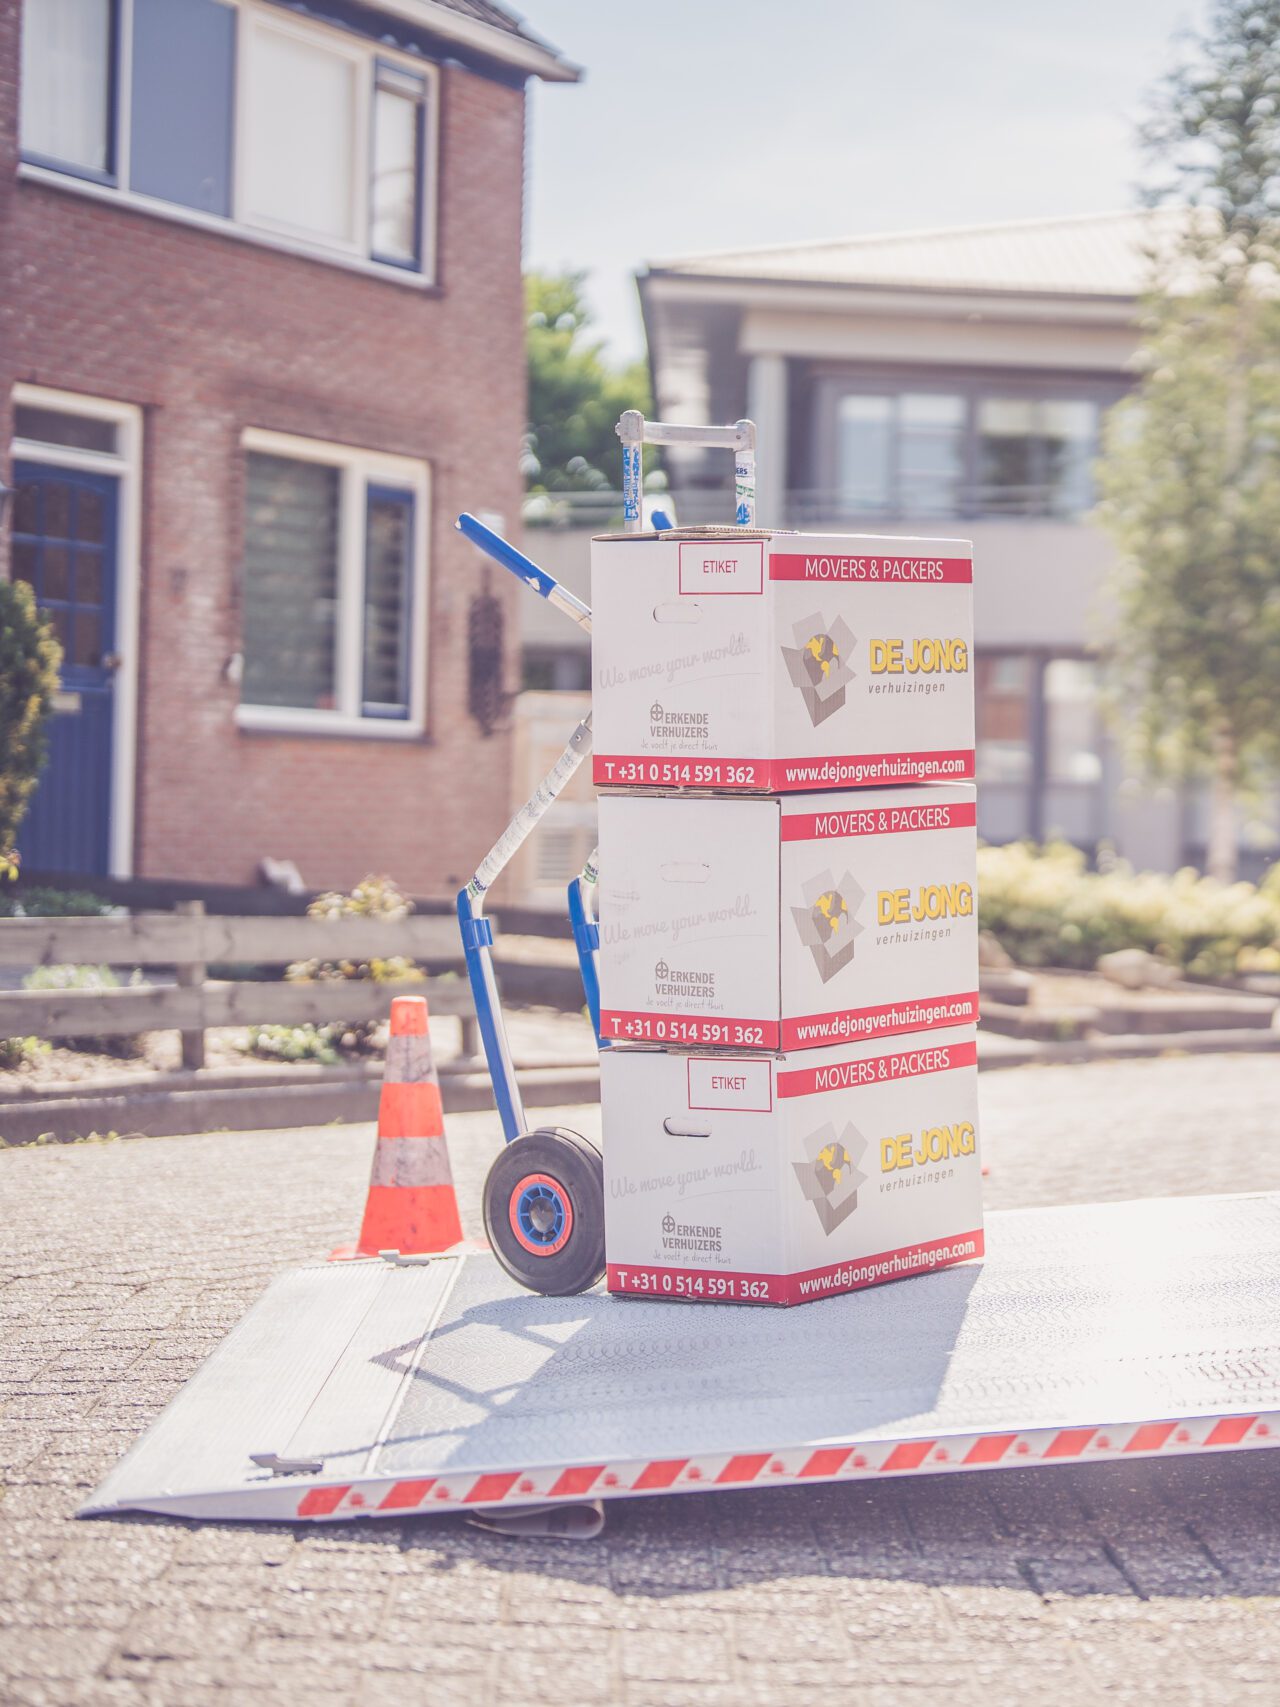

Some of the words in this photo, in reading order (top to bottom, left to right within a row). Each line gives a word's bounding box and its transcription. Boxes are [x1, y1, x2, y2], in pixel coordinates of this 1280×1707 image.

[703, 560, 738, 573] ETIKET
[805, 558, 866, 578] MOVERS
[869, 560, 880, 579] &
[883, 560, 944, 580] PACKERS
[869, 639, 904, 674] DE
[905, 637, 969, 674] JONG
[600, 665, 626, 689] We
[629, 662, 664, 682] move
[666, 654, 700, 683] your
[868, 681, 945, 695] verhuizingen
[665, 712, 709, 725] ERKENDE
[650, 725, 709, 738] VERHUIZERS
[605, 762, 615, 779] T
[618, 763, 644, 780] +31
[649, 764, 659, 781] 0
[662, 764, 690, 782] 514
[694, 765, 721, 782] 591
[726, 766, 755, 783] 362
[785, 758, 965, 783] www.dejongverhuizingen.com
[815, 812, 875, 836] MOVERS
[878, 812, 888, 831] &
[891, 807, 950, 830] PACKERS
[877, 888, 912, 926] DE
[911, 881, 974, 923] JONG
[603, 922, 631, 944] We
[633, 920, 668, 938] move
[671, 914, 706, 941] your
[876, 927, 951, 946] verhuizingen
[670, 971, 715, 985] ERKENDE
[655, 984, 715, 998] VERHUIZERS
[611, 1018, 621, 1034] T
[625, 1018, 650, 1037] +31
[656, 1020, 666, 1038] 0
[669, 1022, 698, 1040] 514
[702, 1024, 729, 1042] 591
[734, 1026, 764, 1044] 362
[797, 1001, 973, 1040] www.dejongverhuizingen.com
[815, 1061, 875, 1090] MOVERS
[878, 1060, 888, 1079] &
[891, 1048, 950, 1076] PACKERS
[711, 1076, 747, 1090] ETIKET
[880, 1133, 913, 1174] DE
[914, 1121, 976, 1165] JONG
[611, 1176, 637, 1199] We
[640, 1175, 675, 1193] move
[677, 1168, 711, 1195] your
[879, 1168, 954, 1193] verhuizingen
[677, 1225, 722, 1238] ERKENDE
[662, 1237, 722, 1252] VERHUIZERS
[799, 1238, 976, 1295] www.dejongverhuizingen.com
[617, 1271, 627, 1288] T
[631, 1272, 657, 1290] +31
[662, 1275, 672, 1291] 0
[675, 1276, 704, 1294] 514
[708, 1278, 734, 1296] 591
[740, 1280, 769, 1298] 362
